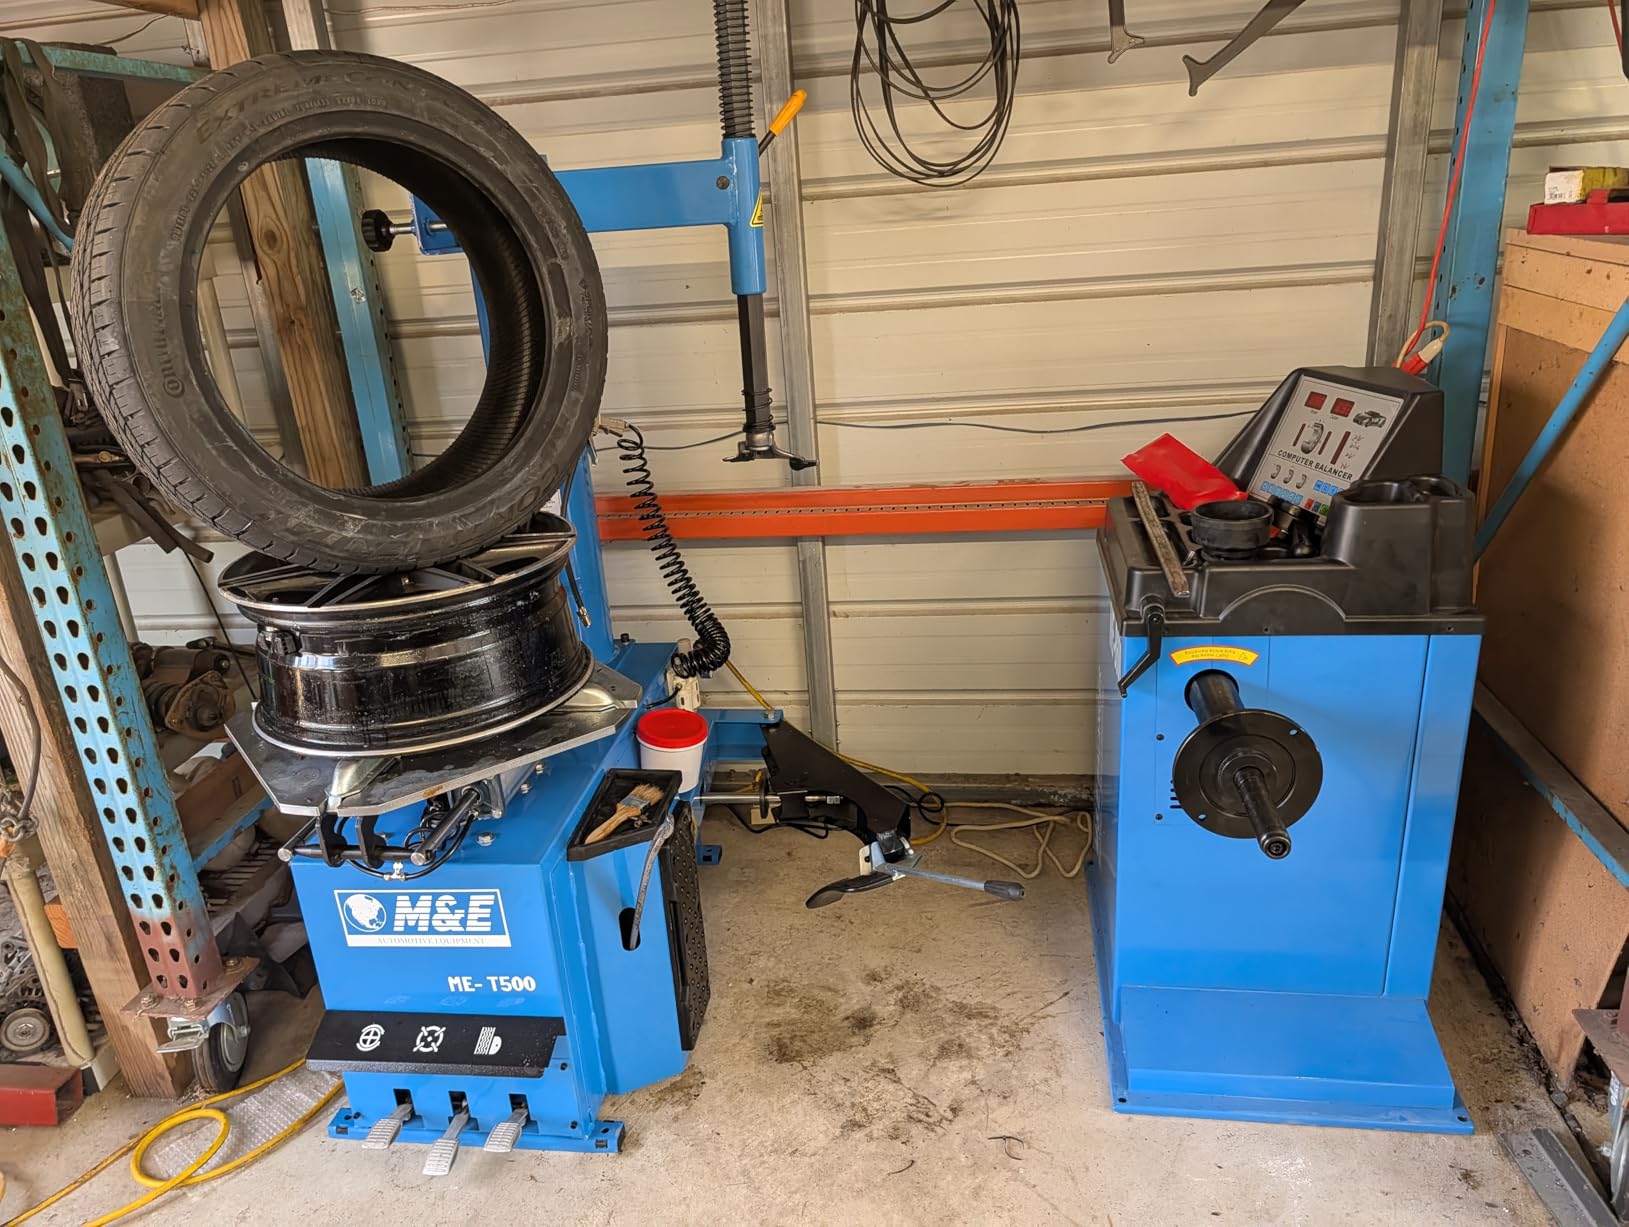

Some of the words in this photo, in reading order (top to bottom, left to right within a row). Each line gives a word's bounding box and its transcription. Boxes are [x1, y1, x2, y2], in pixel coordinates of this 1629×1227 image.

[1277, 449, 1313, 467] COMPUTER
[1314, 462, 1353, 480] BALANCER
[392, 894, 495, 932] M&E
[376, 937, 434, 945] AUTOMOTIVE
[434, 936, 487, 945] EQUIPMENT
[447, 976, 483, 992] ME-
[486, 976, 537, 992] T500
